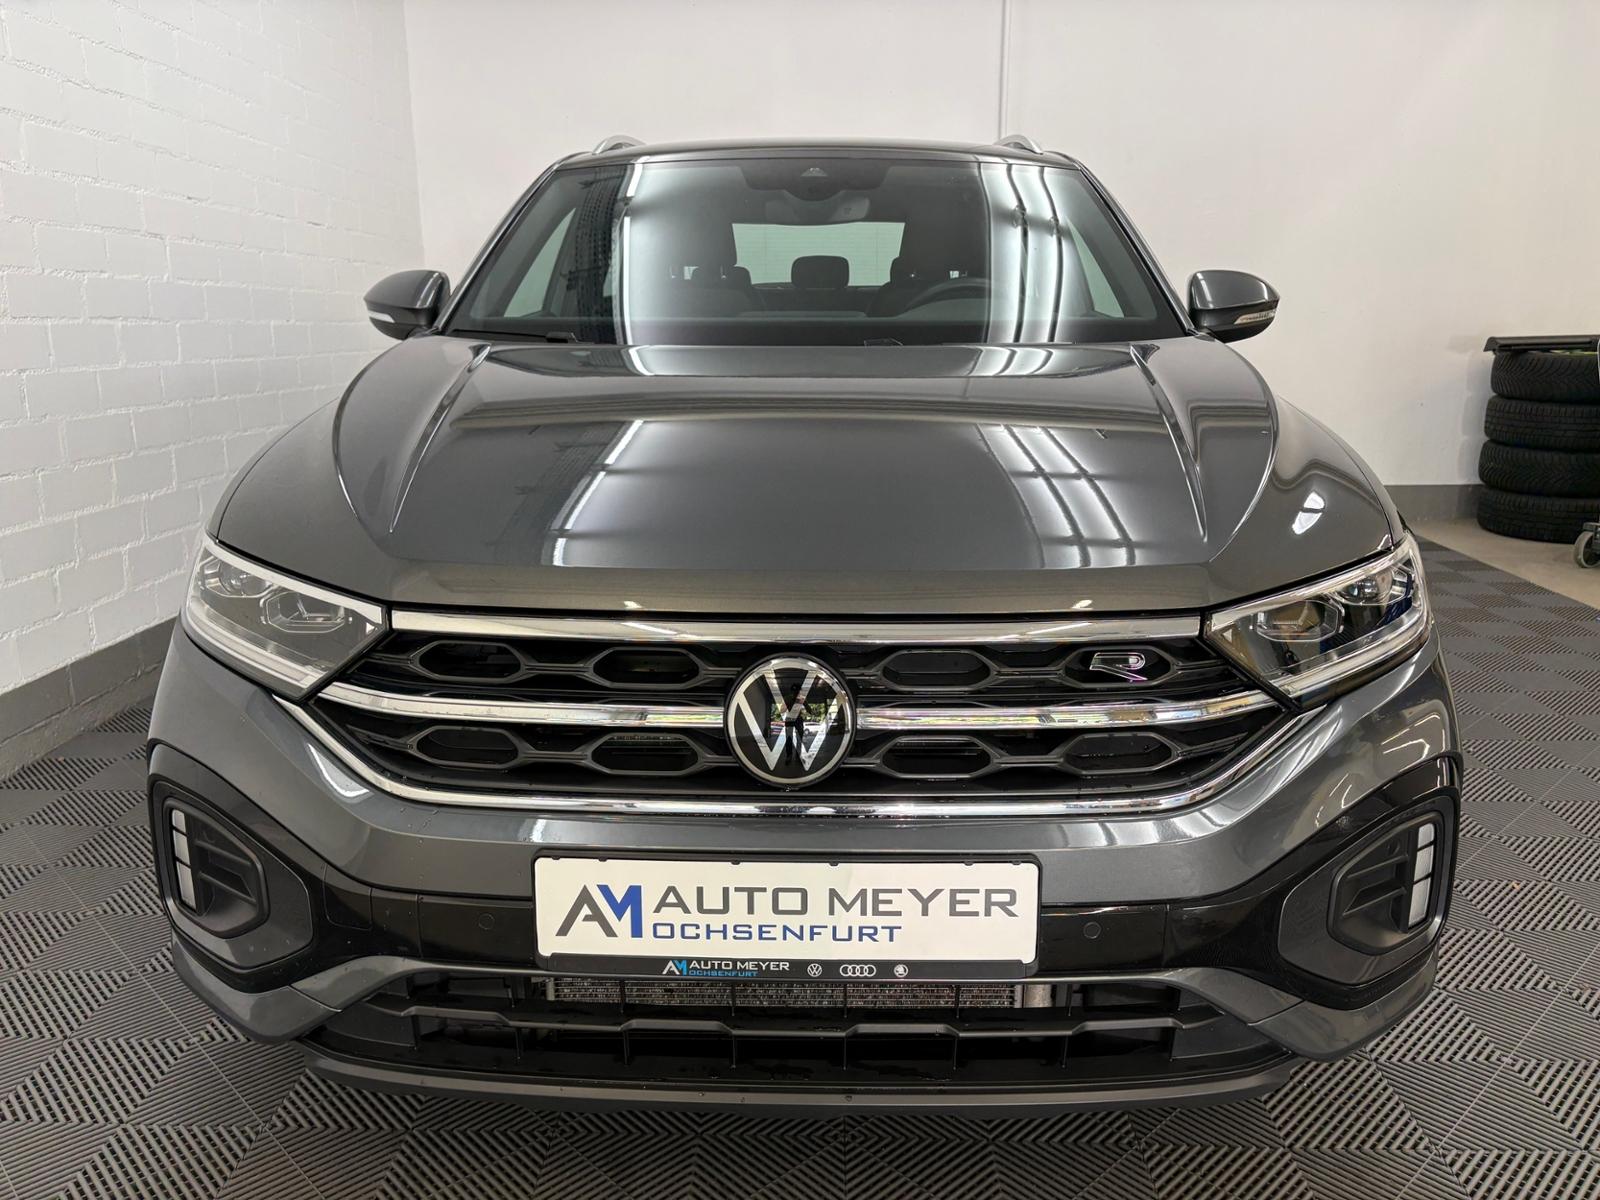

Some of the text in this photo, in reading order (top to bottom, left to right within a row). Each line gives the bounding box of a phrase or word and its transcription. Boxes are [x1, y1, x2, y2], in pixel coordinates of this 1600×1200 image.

[735, 660, 846, 771] VW
[652, 885, 1020, 919] AUTO MEYER
[652, 922, 902, 943] OCHSENFURT
[689, 960, 790, 971] AUTO MEYER
